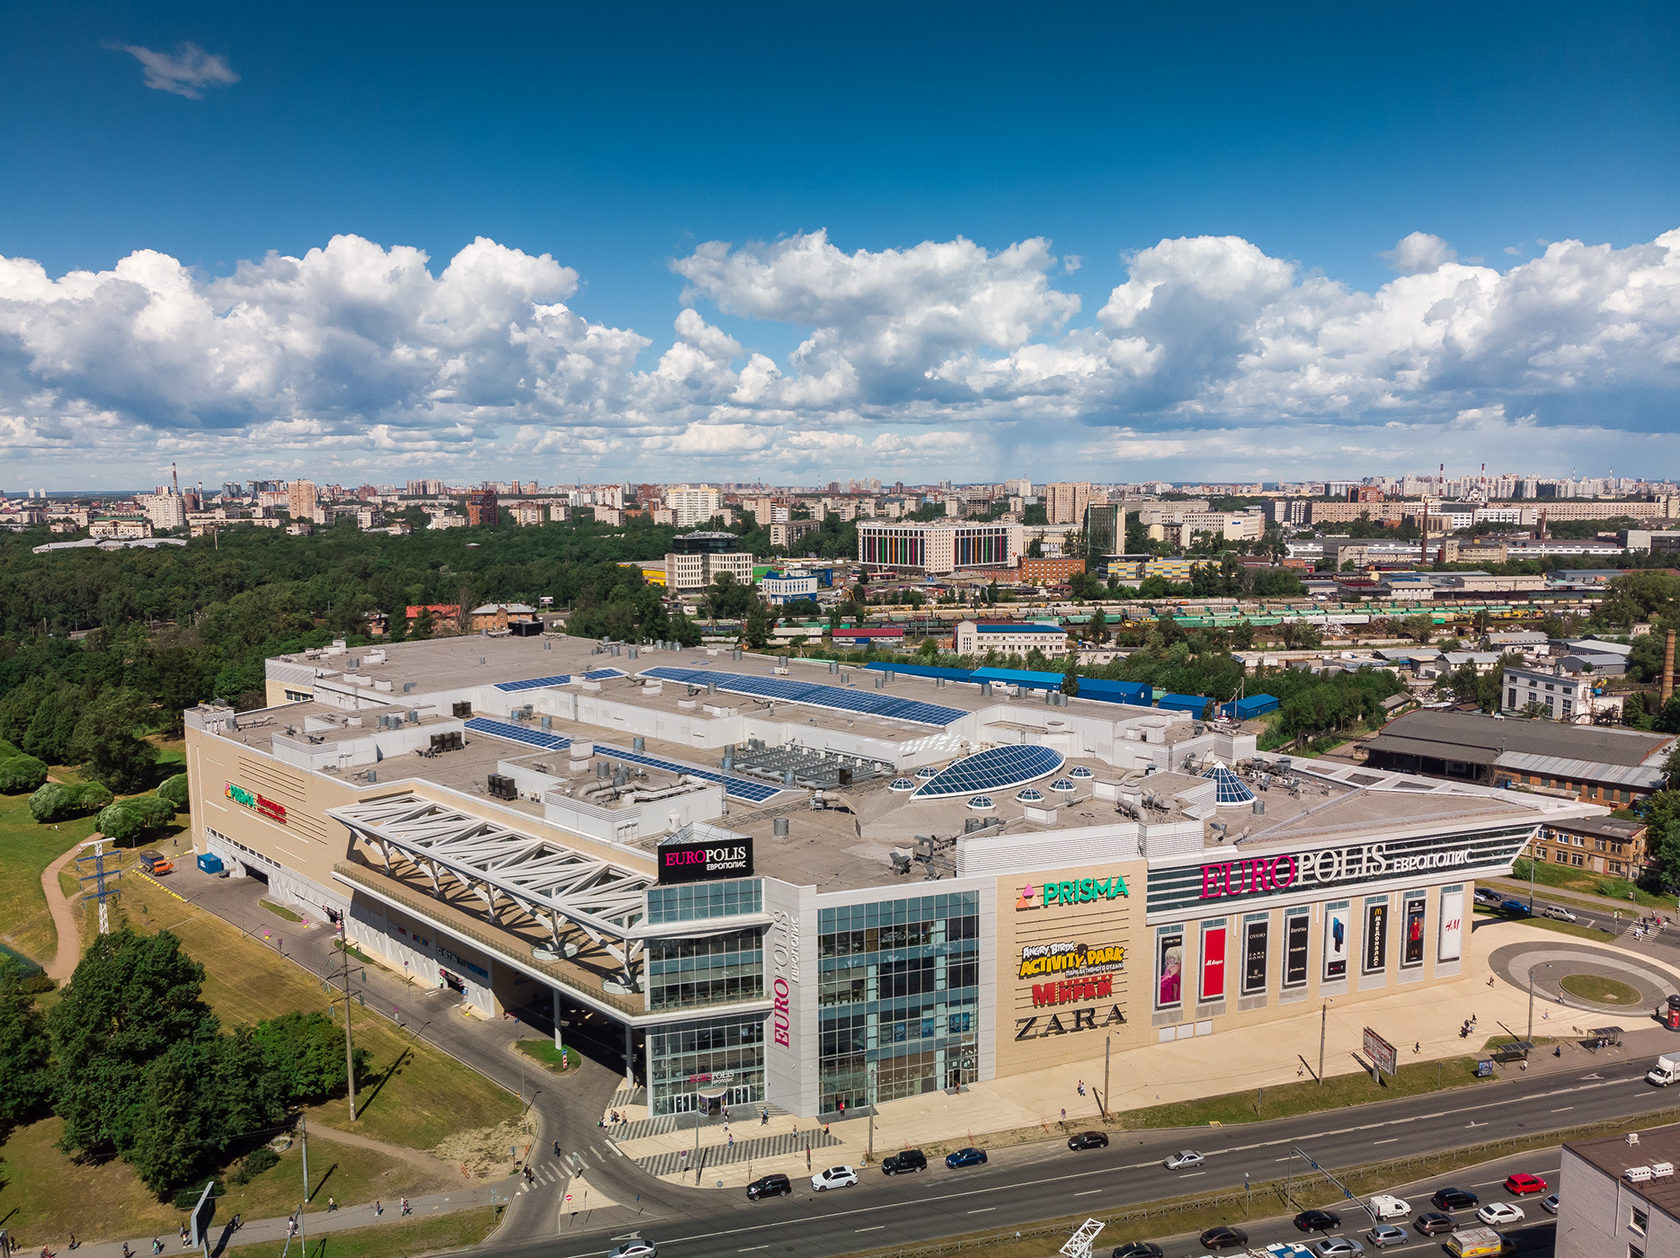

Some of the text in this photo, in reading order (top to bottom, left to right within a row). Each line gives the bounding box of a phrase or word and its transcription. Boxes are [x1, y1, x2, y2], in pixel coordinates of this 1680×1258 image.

[665, 846, 746, 866] EUROPOLIS
[706, 860, 746, 871] ЕВРОПОЛИС
[1200, 842, 1474, 899] EUROPOLIS ЕВРОПОЛИС
[1044, 874, 1129, 907] PRISMA
[1445, 919, 1460, 931] H&M
[1020, 947, 1124, 977] ACTIVITY PARK
[1022, 941, 1075, 960] ANGRY BIRDS
[773, 909, 790, 1049] EUROPOLIS
[1064, 975, 1110, 985] CINEMA
[1015, 1003, 1127, 1041] ZARA
